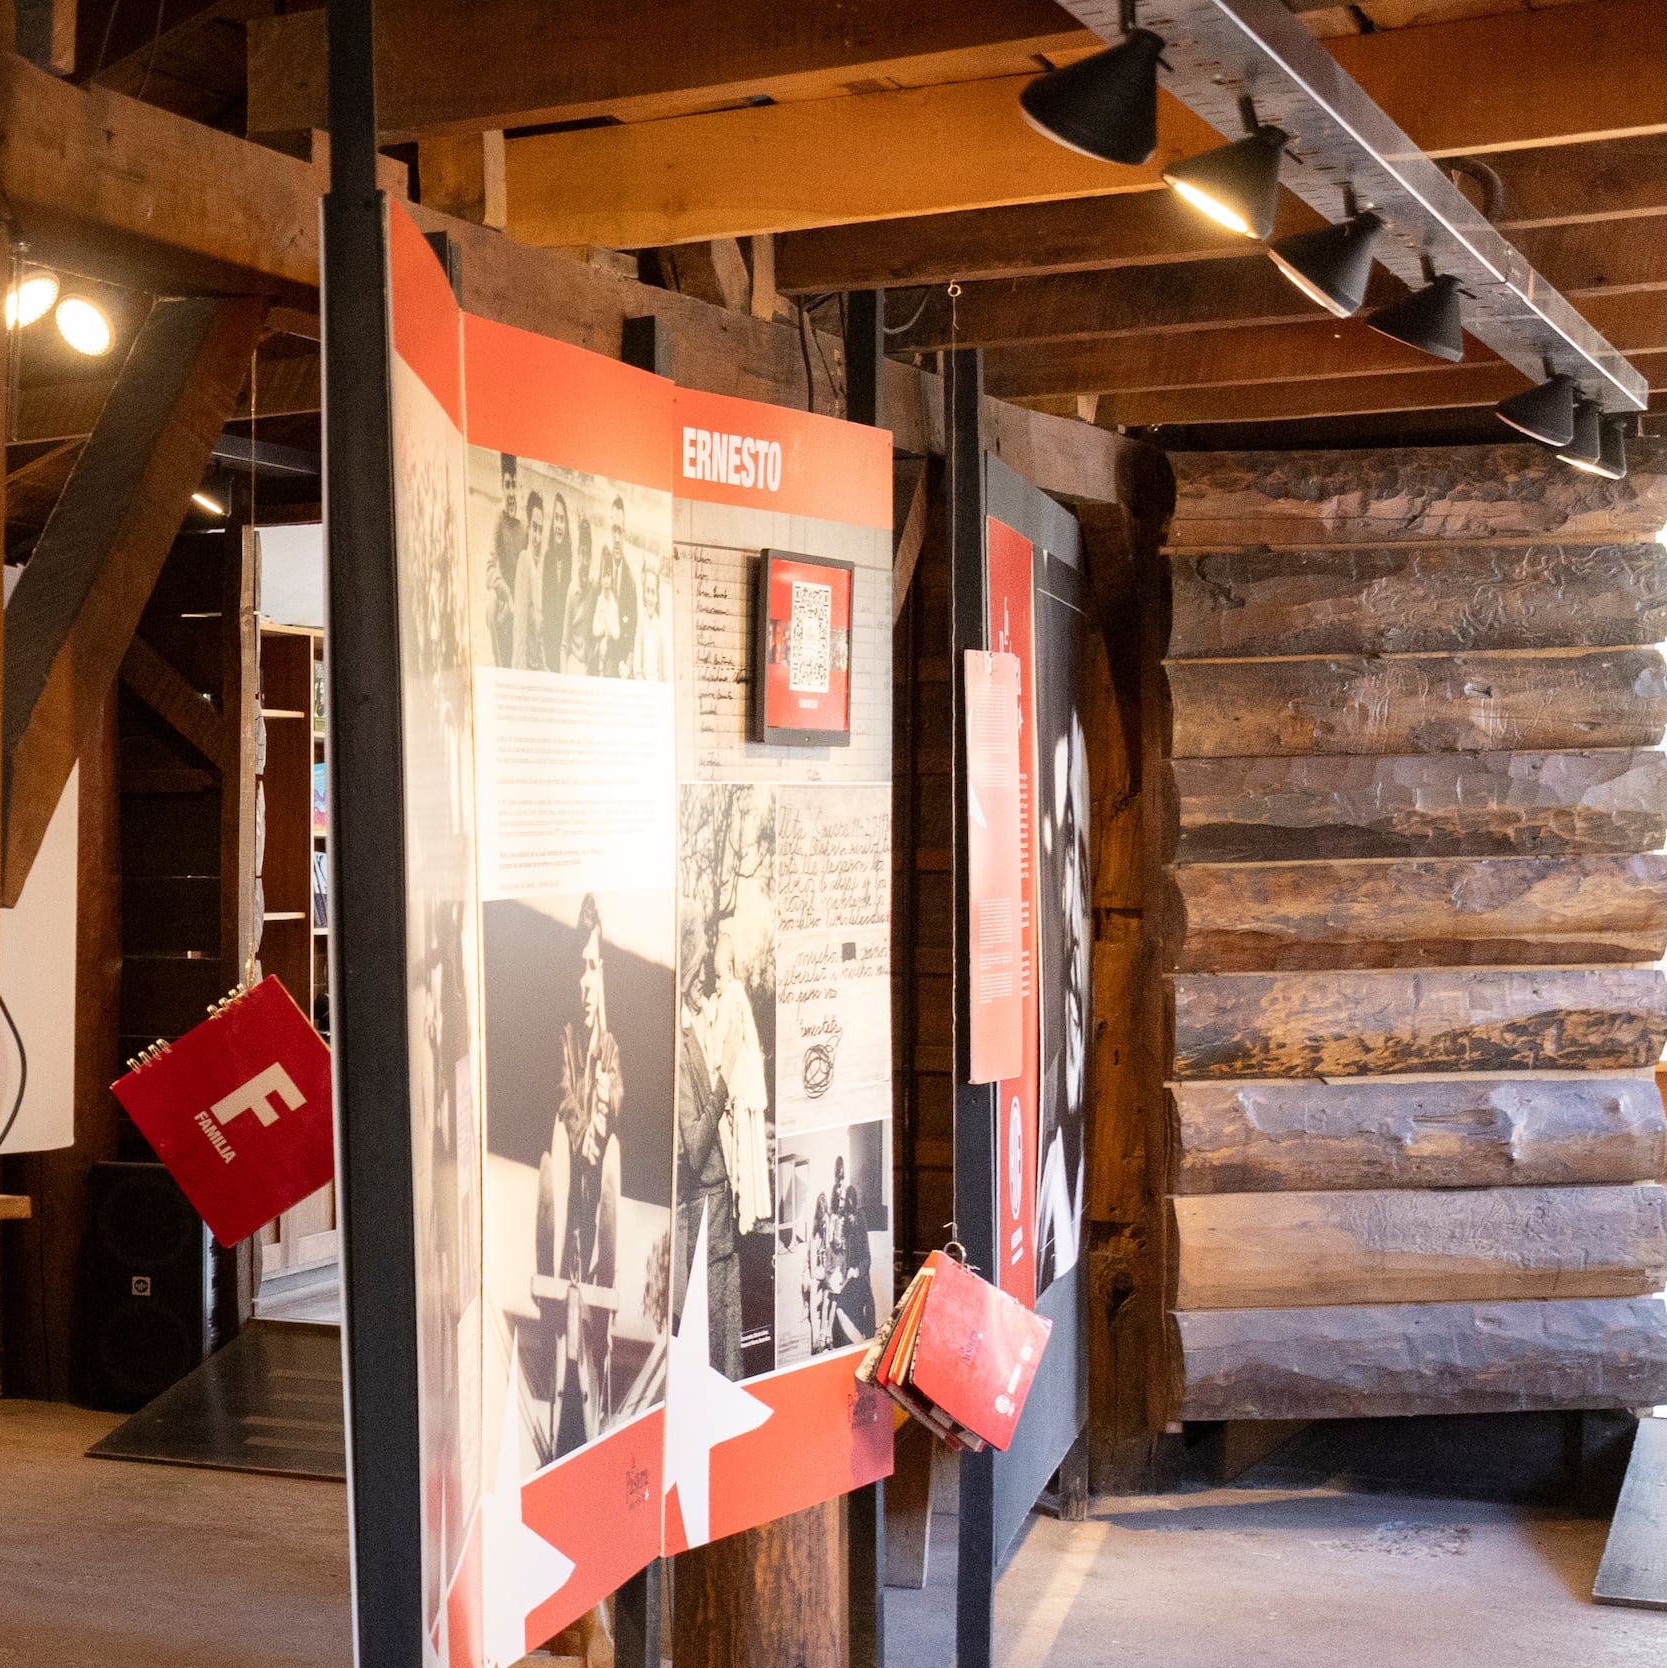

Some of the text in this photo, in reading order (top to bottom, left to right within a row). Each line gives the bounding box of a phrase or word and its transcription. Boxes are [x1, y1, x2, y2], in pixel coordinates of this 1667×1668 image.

[682, 426, 782, 493] ERNESTO
[210, 1061, 307, 1128] F
[193, 1110, 237, 1164] FAMILIA
